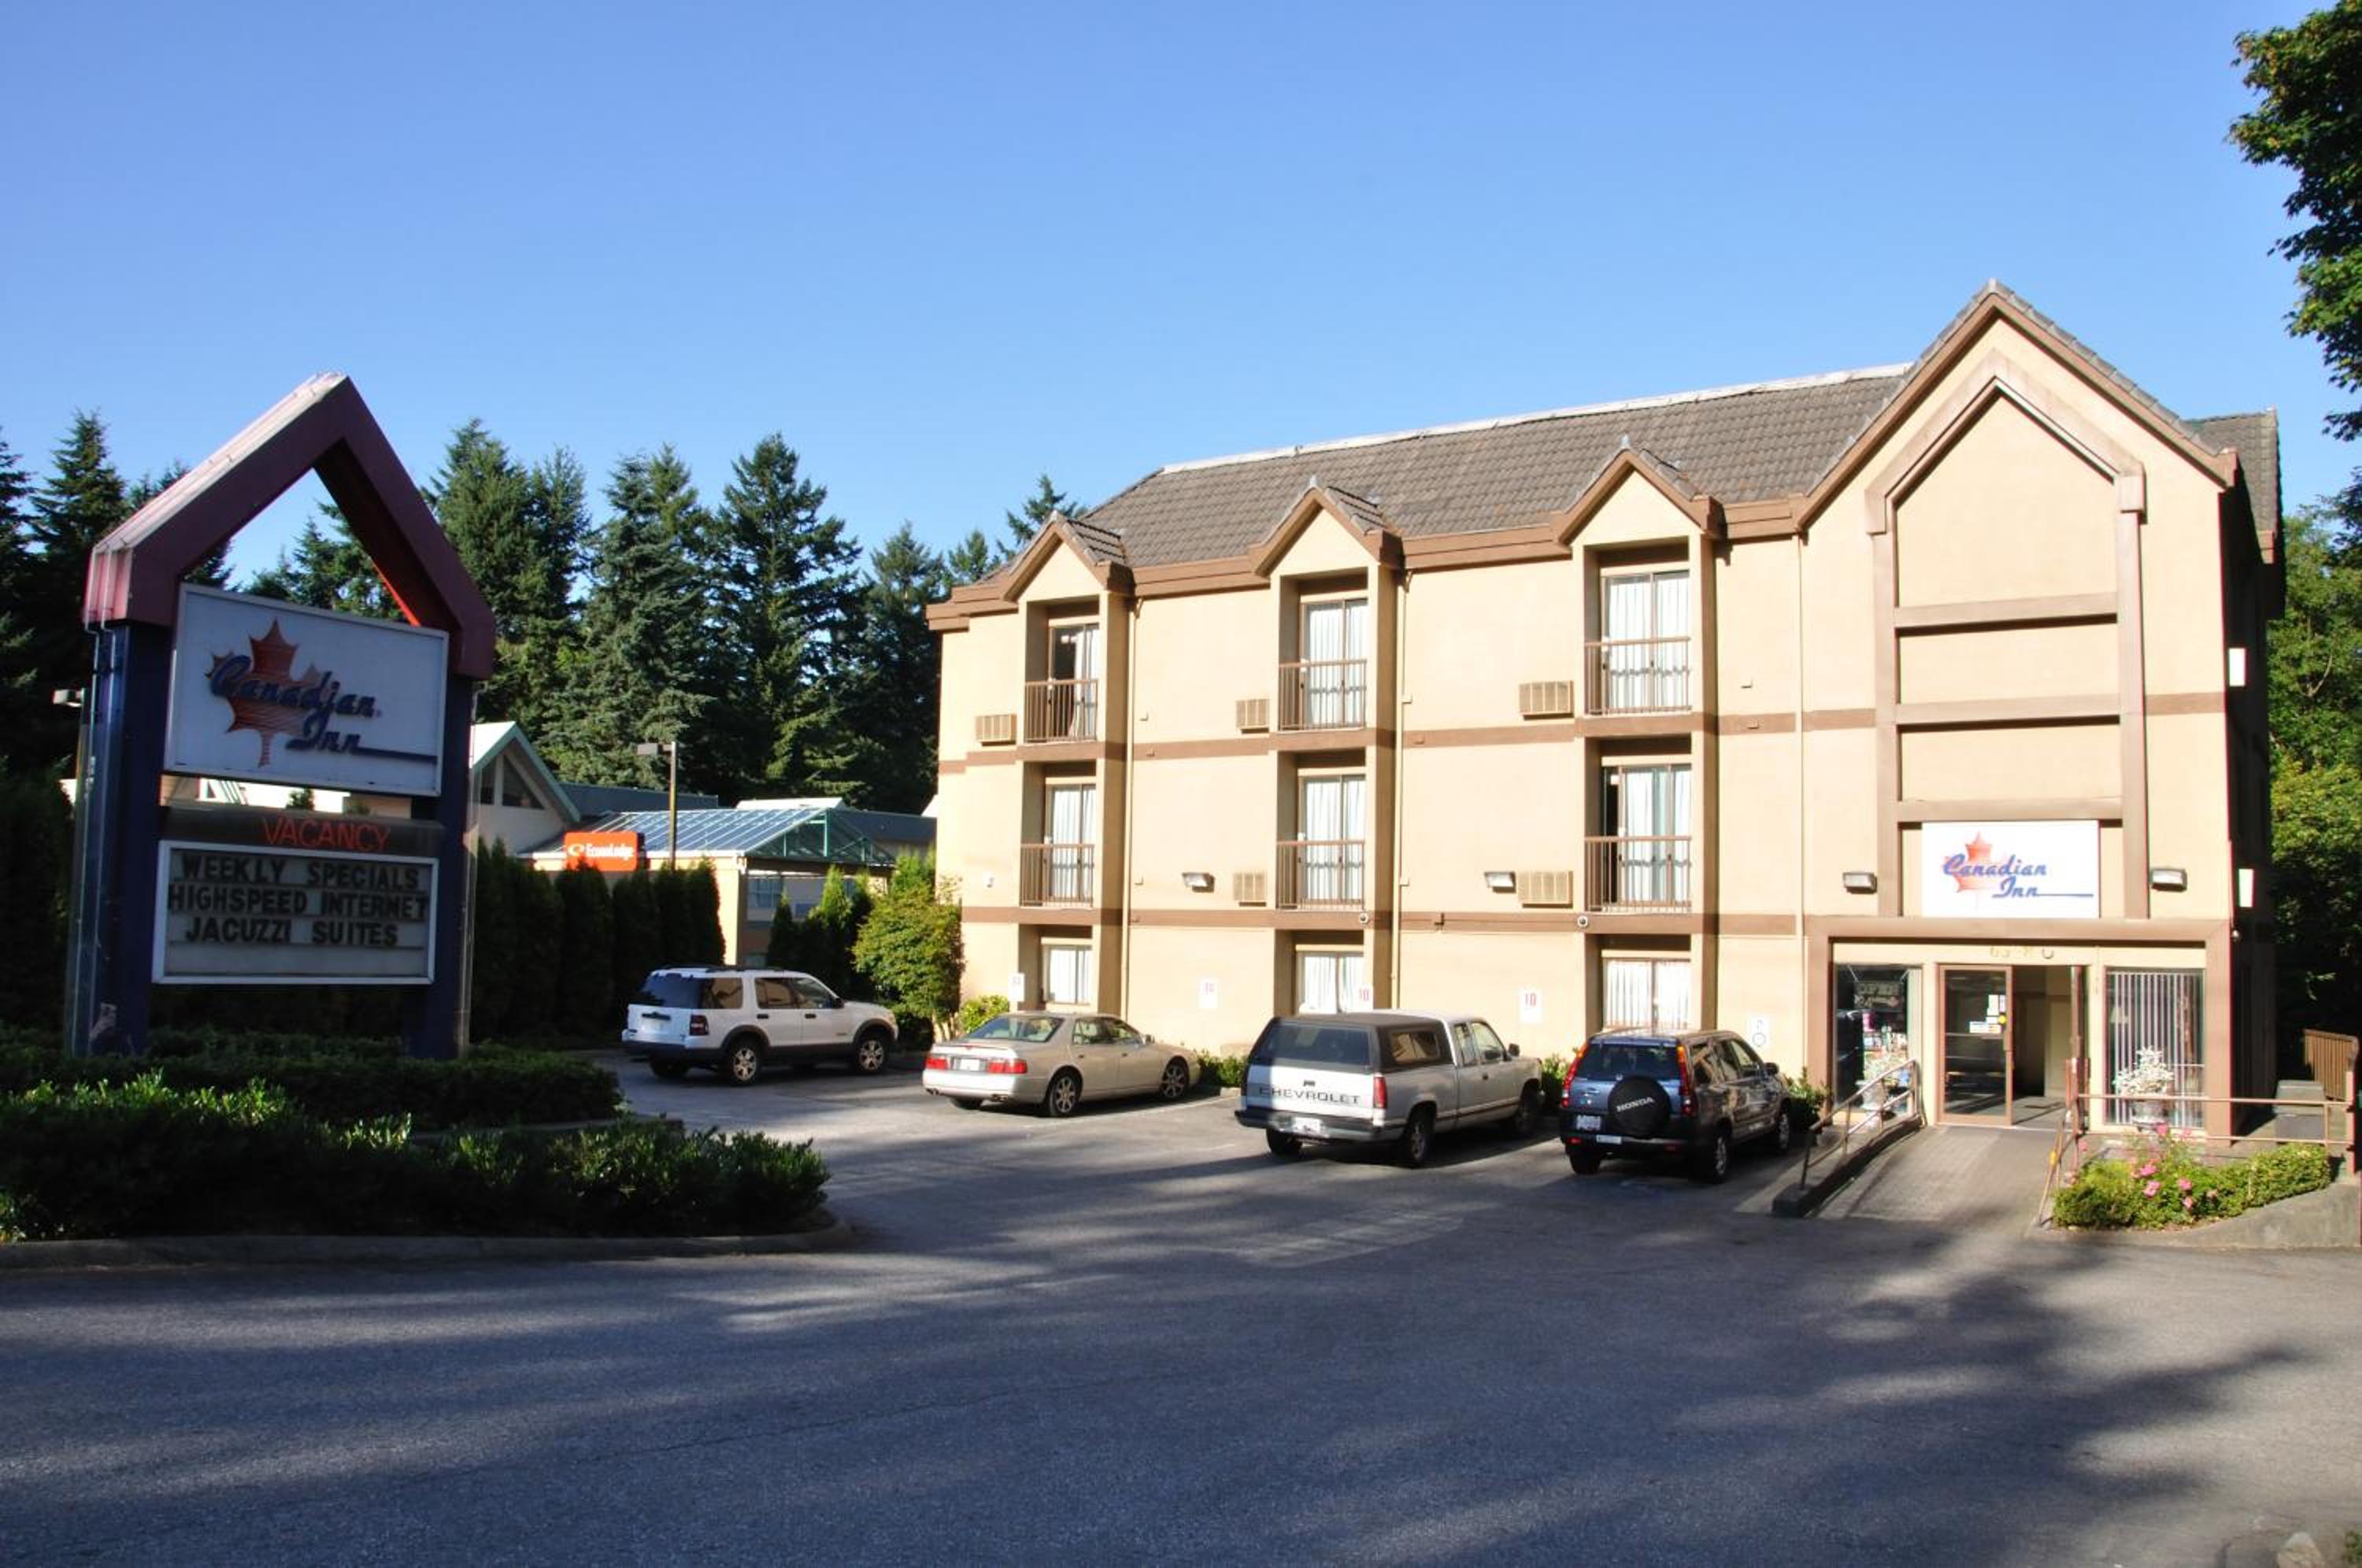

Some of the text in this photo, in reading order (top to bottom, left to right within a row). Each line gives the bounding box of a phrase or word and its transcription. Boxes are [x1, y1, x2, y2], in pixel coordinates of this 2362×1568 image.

[209, 654, 376, 718] Canadian
[262, 818, 391, 851] VACANCY
[182, 855, 418, 890] WEEKLY SPECIALS
[1942, 852, 2047, 877] Canadian
[168, 882, 430, 921] HIGHSPEED INTERNET
[186, 916, 398, 945] JACUZZI SUITES
[1259, 1084, 1361, 1104] CHEVROLET
[1616, 1096, 1655, 1112] HONDA
